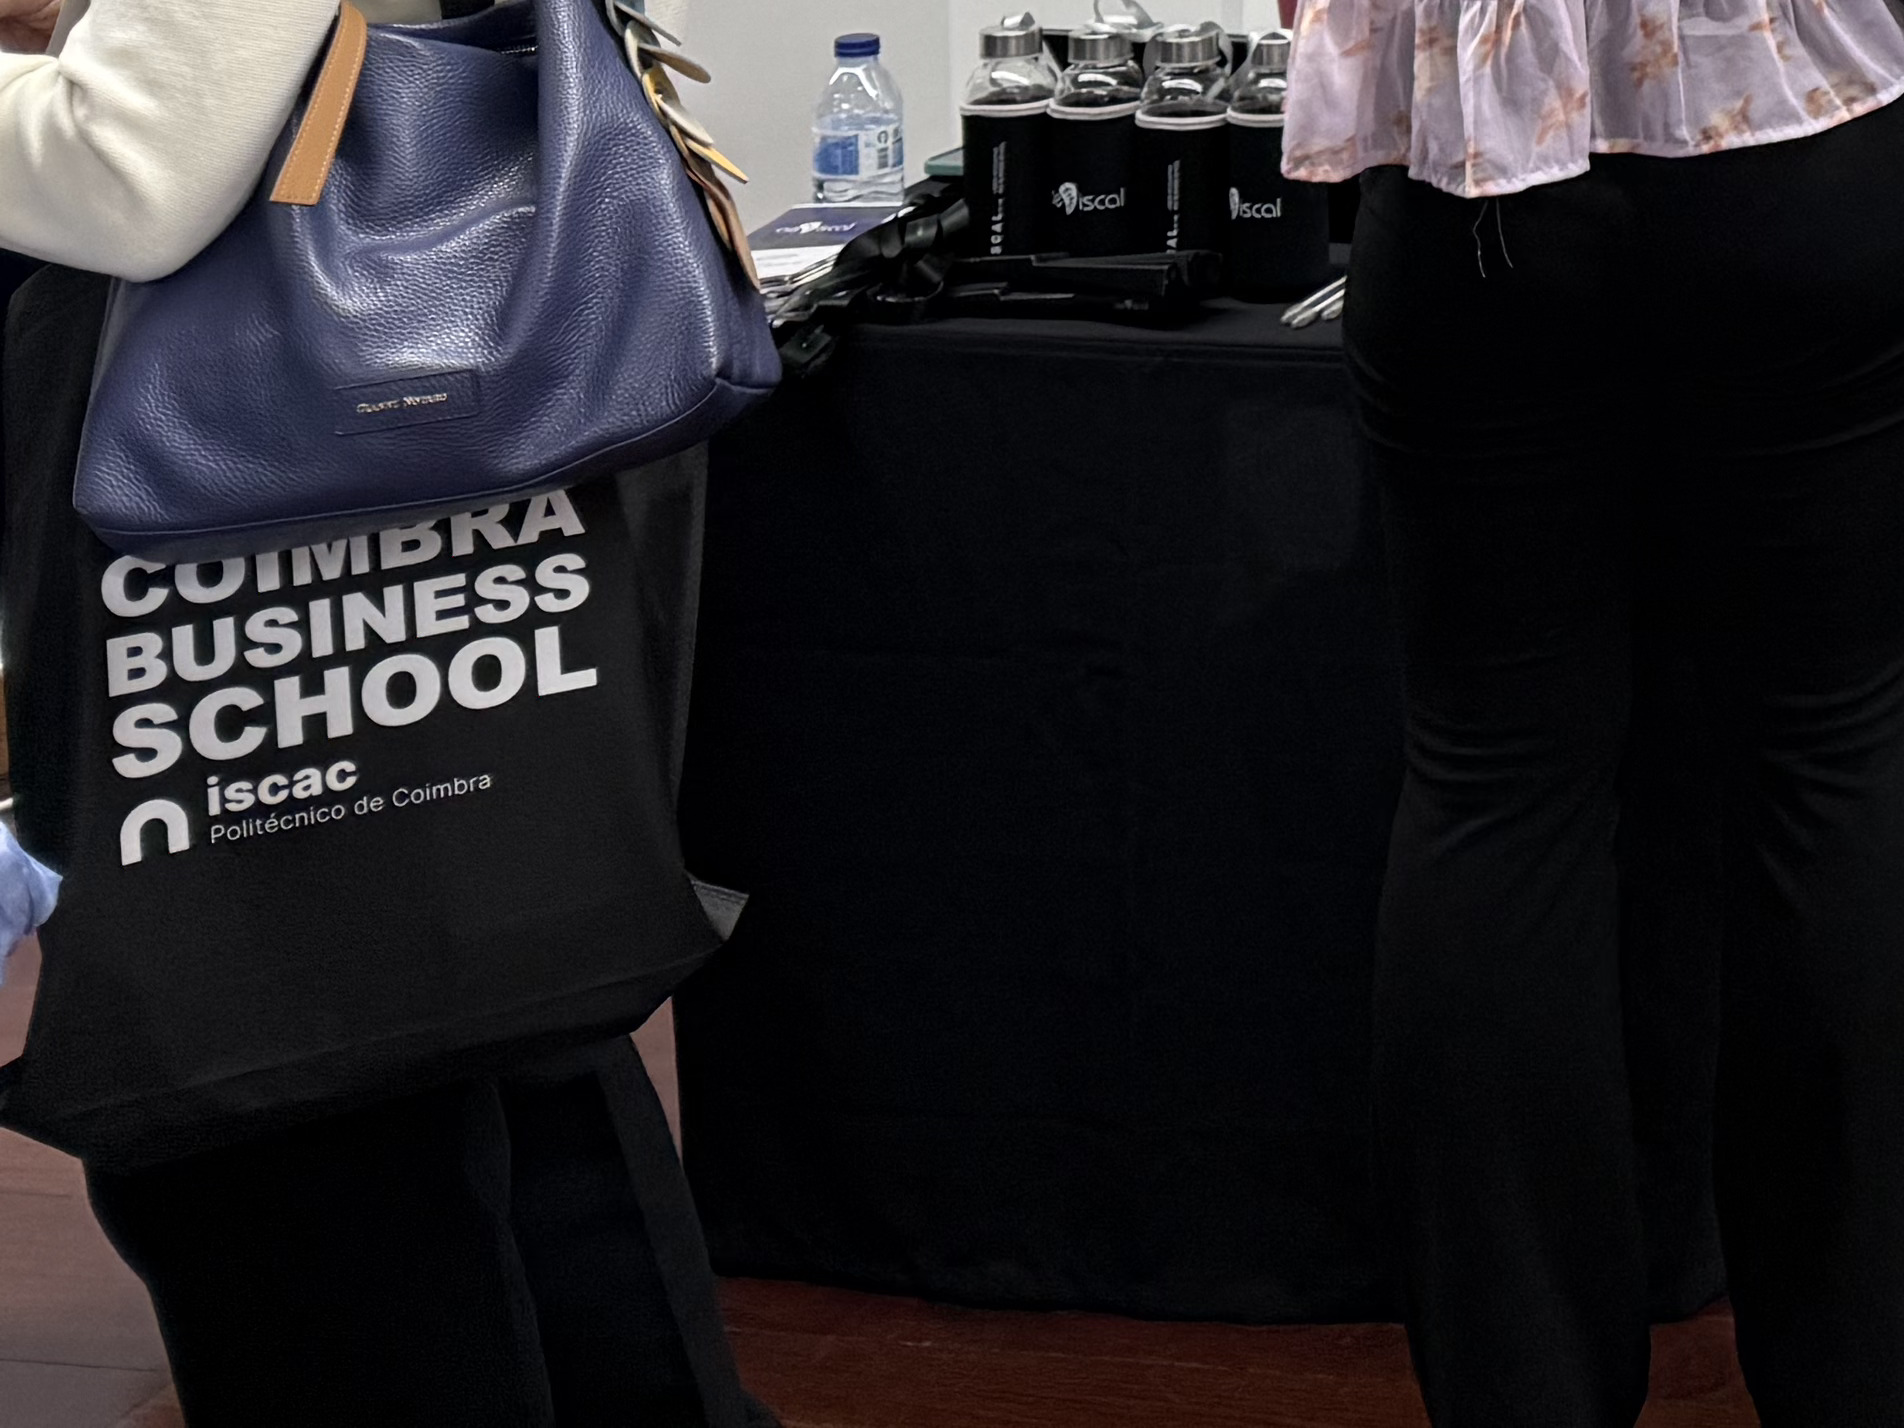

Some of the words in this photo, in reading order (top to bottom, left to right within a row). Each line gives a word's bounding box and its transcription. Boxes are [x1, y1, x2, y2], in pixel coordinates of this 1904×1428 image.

[101, 488, 586, 618] COIMBRA
[106, 553, 590, 697] BUSINESS
[112, 626, 598, 779] SCHOOL
[207, 760, 359, 816] iscac
[210, 803, 346, 844] Politécnico
[354, 795, 384, 817] de
[392, 773, 492, 808] Coimbra
